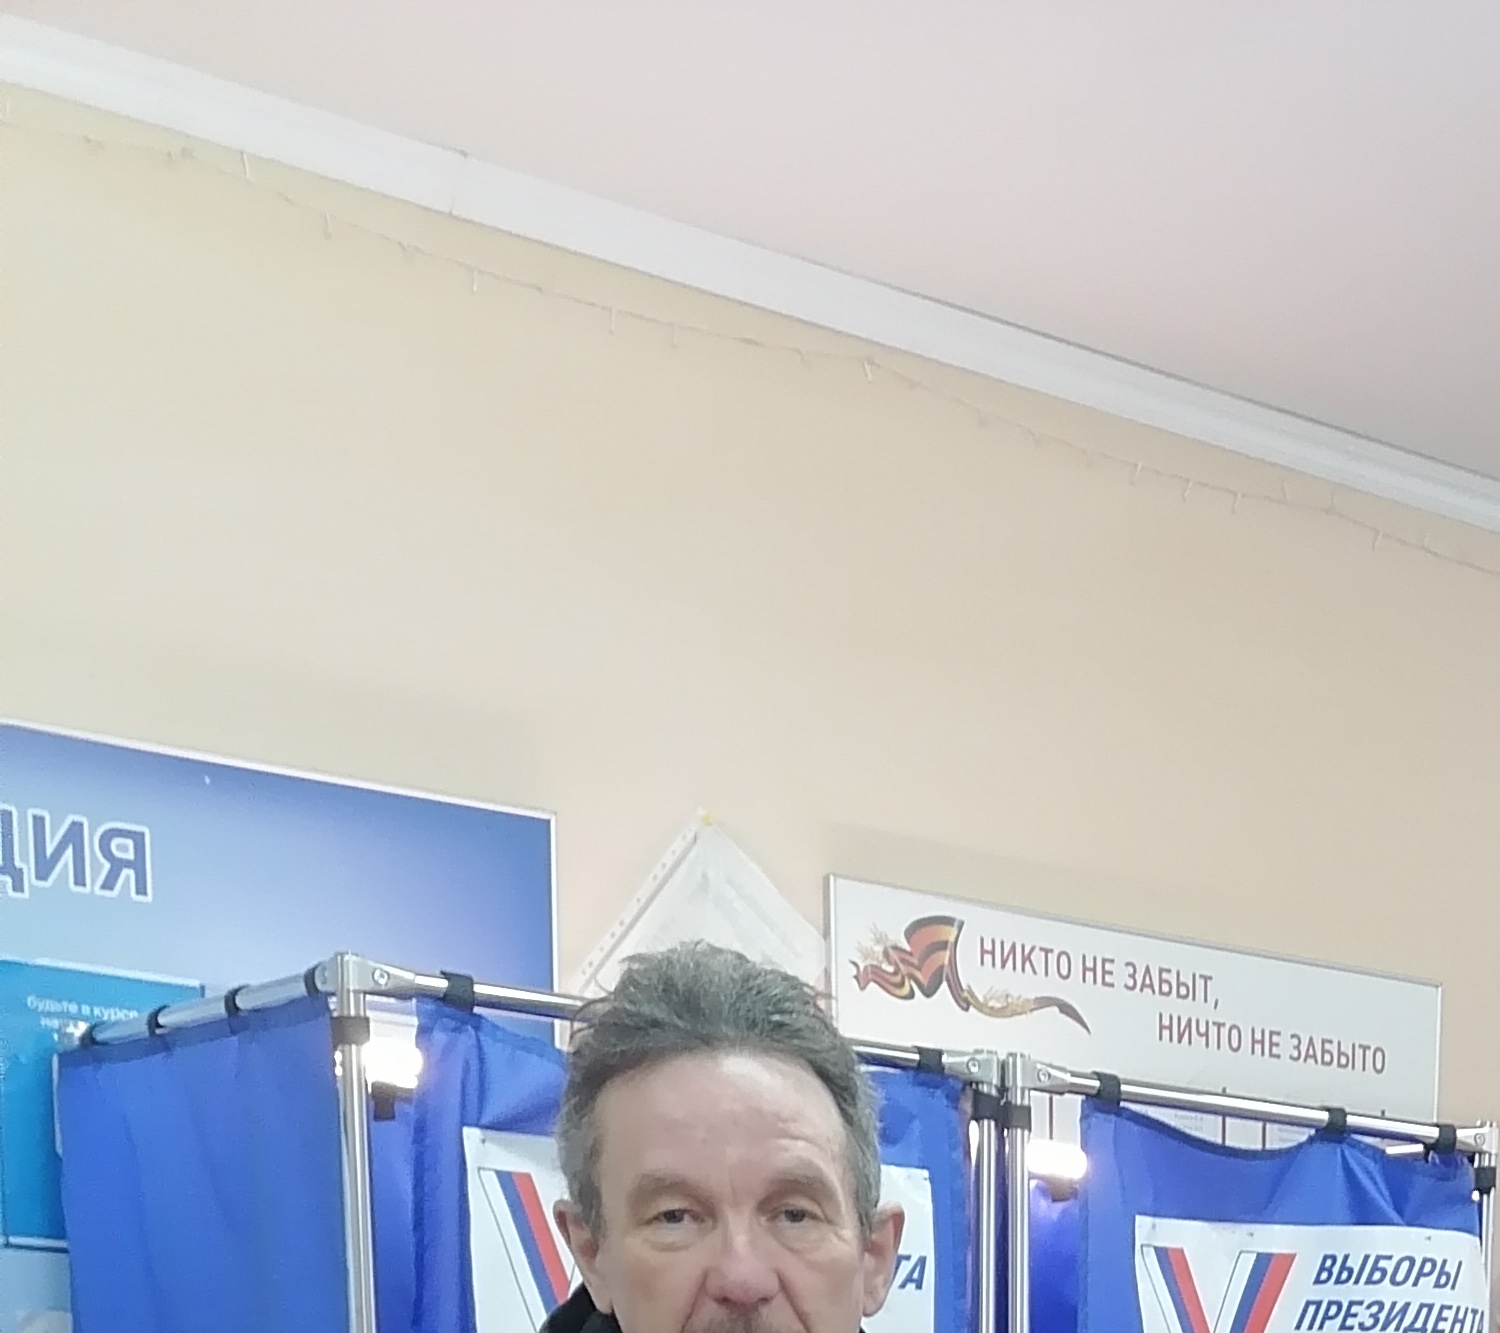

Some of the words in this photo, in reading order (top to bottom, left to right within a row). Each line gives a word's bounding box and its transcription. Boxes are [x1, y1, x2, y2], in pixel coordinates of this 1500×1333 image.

[979, 936, 1072, 981] НИКТО
[1082, 953, 1115, 987] НЕ
[1124, 961, 1219, 1009] ЗАБЫТ,
[1158, 1012, 1243, 1052] НИЧТО
[1251, 1031, 1281, 1057] НЕ
[1289, 1036, 1386, 1075] ЗАБЫТО
[1312, 1252, 1462, 1291] ВЫБОРЫ
